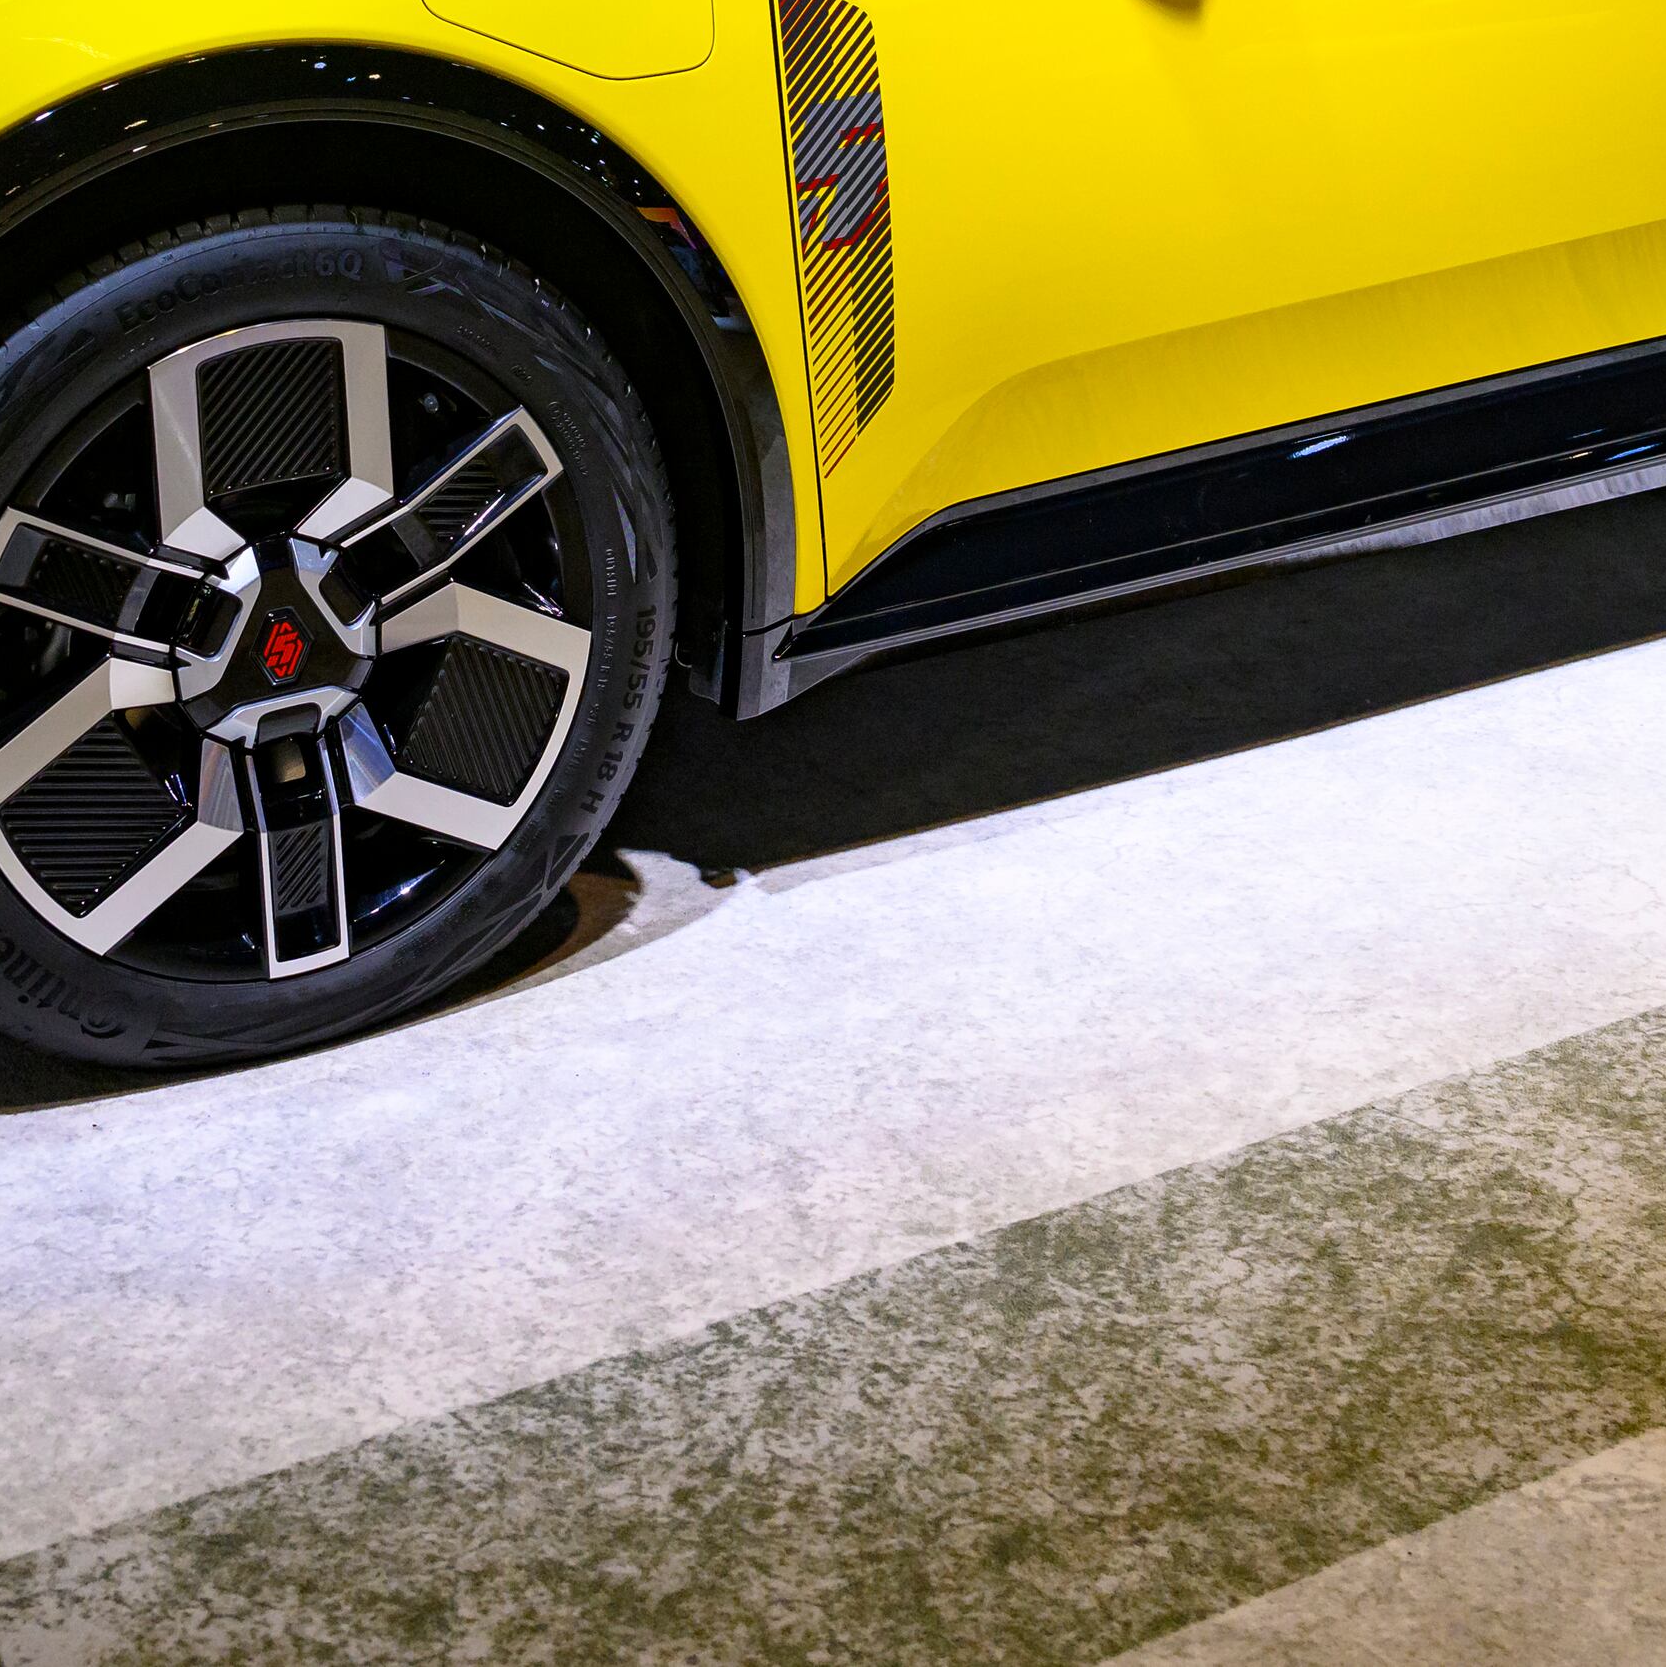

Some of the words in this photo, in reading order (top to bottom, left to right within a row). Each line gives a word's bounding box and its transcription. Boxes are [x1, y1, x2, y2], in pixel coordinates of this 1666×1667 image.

[314, 248, 363, 282] 6Q
[623, 605, 657, 710] 195/55
[611, 721, 635, 742] R
[596, 750, 624, 782] 18
[580, 789, 606, 815] H
